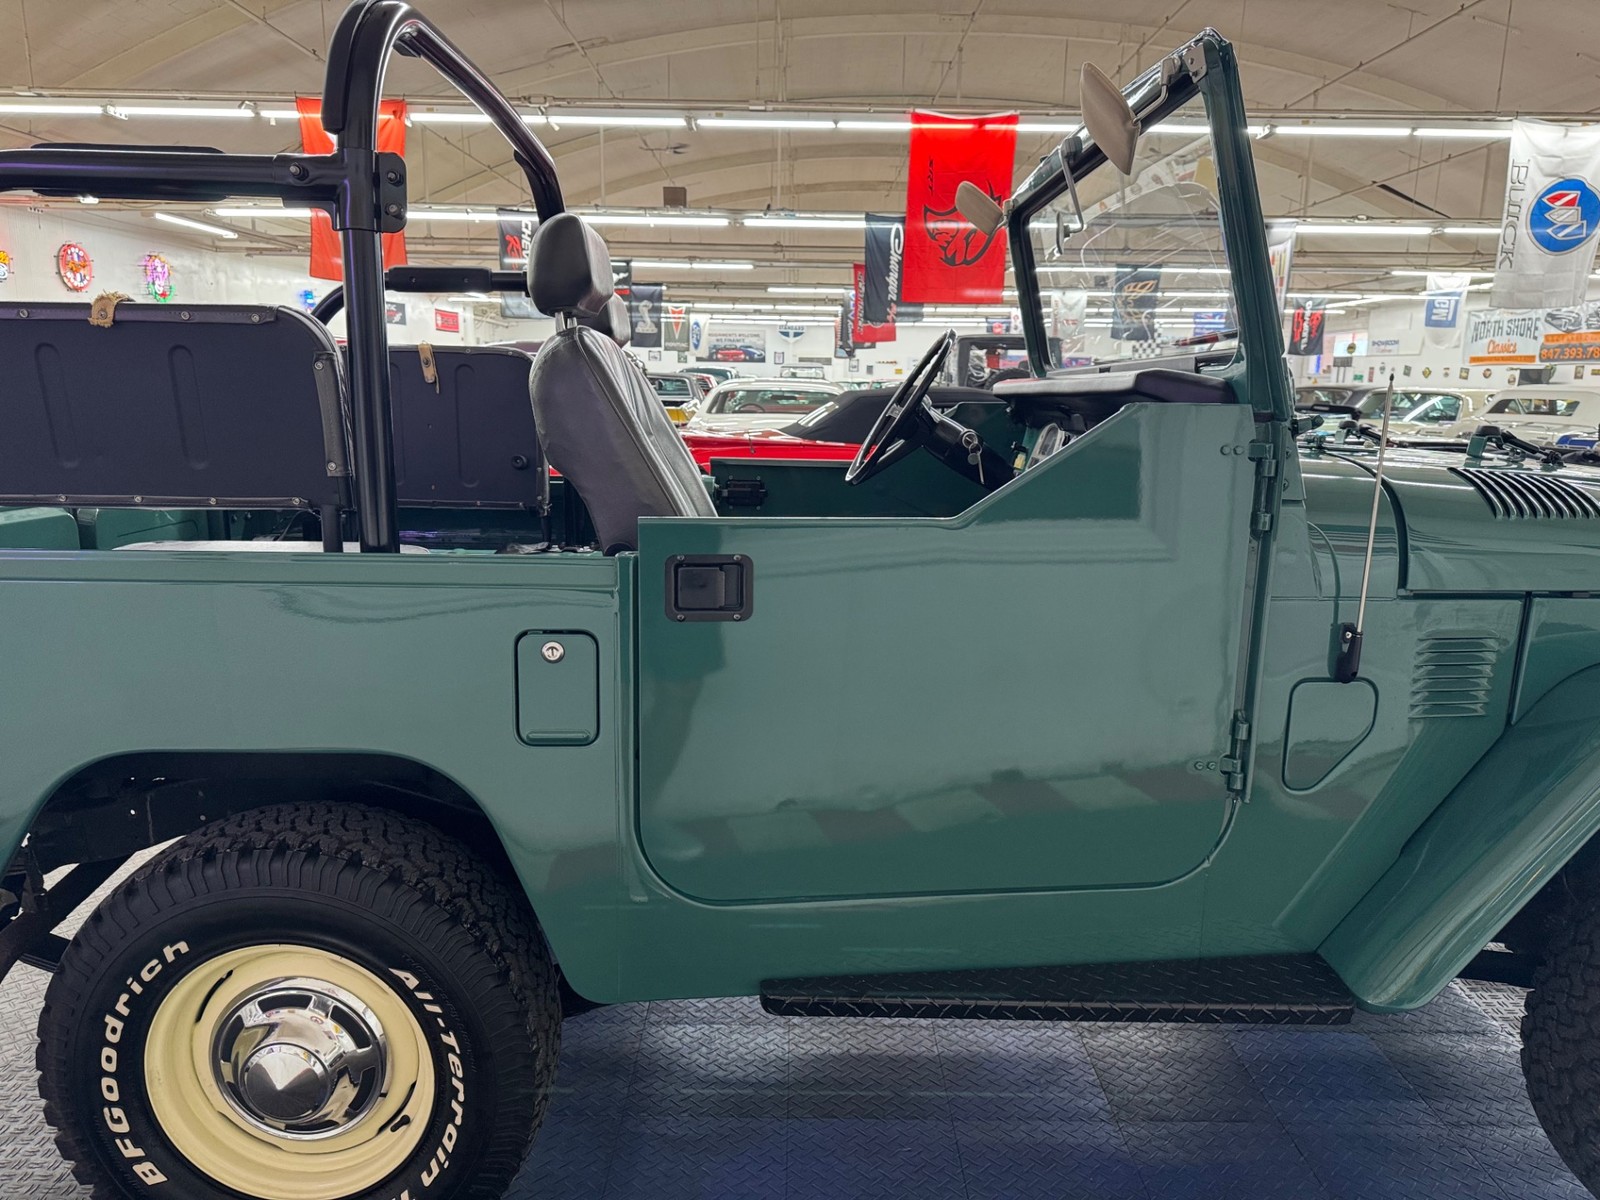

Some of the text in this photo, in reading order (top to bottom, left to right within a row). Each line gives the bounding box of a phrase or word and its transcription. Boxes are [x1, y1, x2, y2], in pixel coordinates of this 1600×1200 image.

[885, 222, 904, 301] Charger
[1499, 159, 1530, 270] BUICK
[1471, 320, 1505, 343] NORTH
[1506, 317, 1540, 341] SHORE
[1487, 339, 1518, 354] Classics
[101, 940, 190, 1186] BFGoodrich
[388, 968, 465, 1187] All-Terrain
